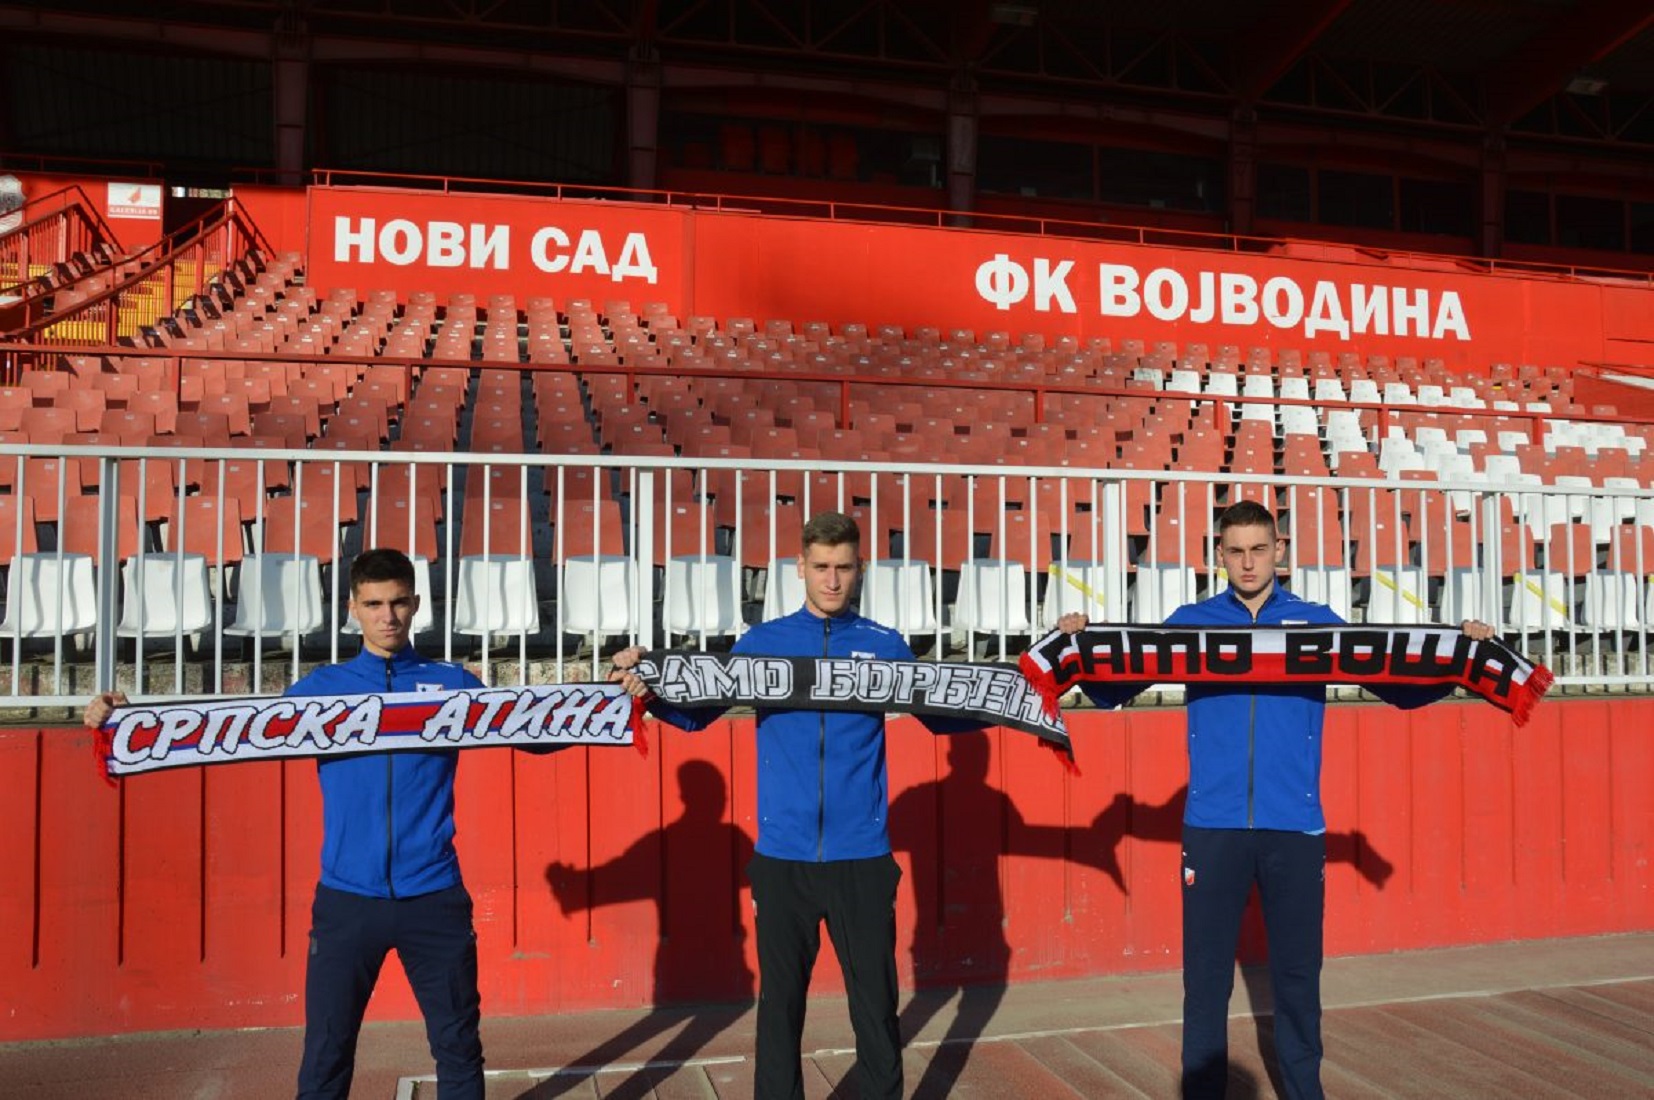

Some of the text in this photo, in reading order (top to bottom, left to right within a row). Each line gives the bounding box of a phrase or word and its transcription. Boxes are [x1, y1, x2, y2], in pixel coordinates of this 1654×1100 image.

[333, 216, 658, 284] НОВИ САД
[974, 253, 1472, 341] ФК ВОЈВОДИНА
[1039, 630, 1521, 698] САМО ВОША
[110, 688, 634, 766] СРПСКА АТИНА
